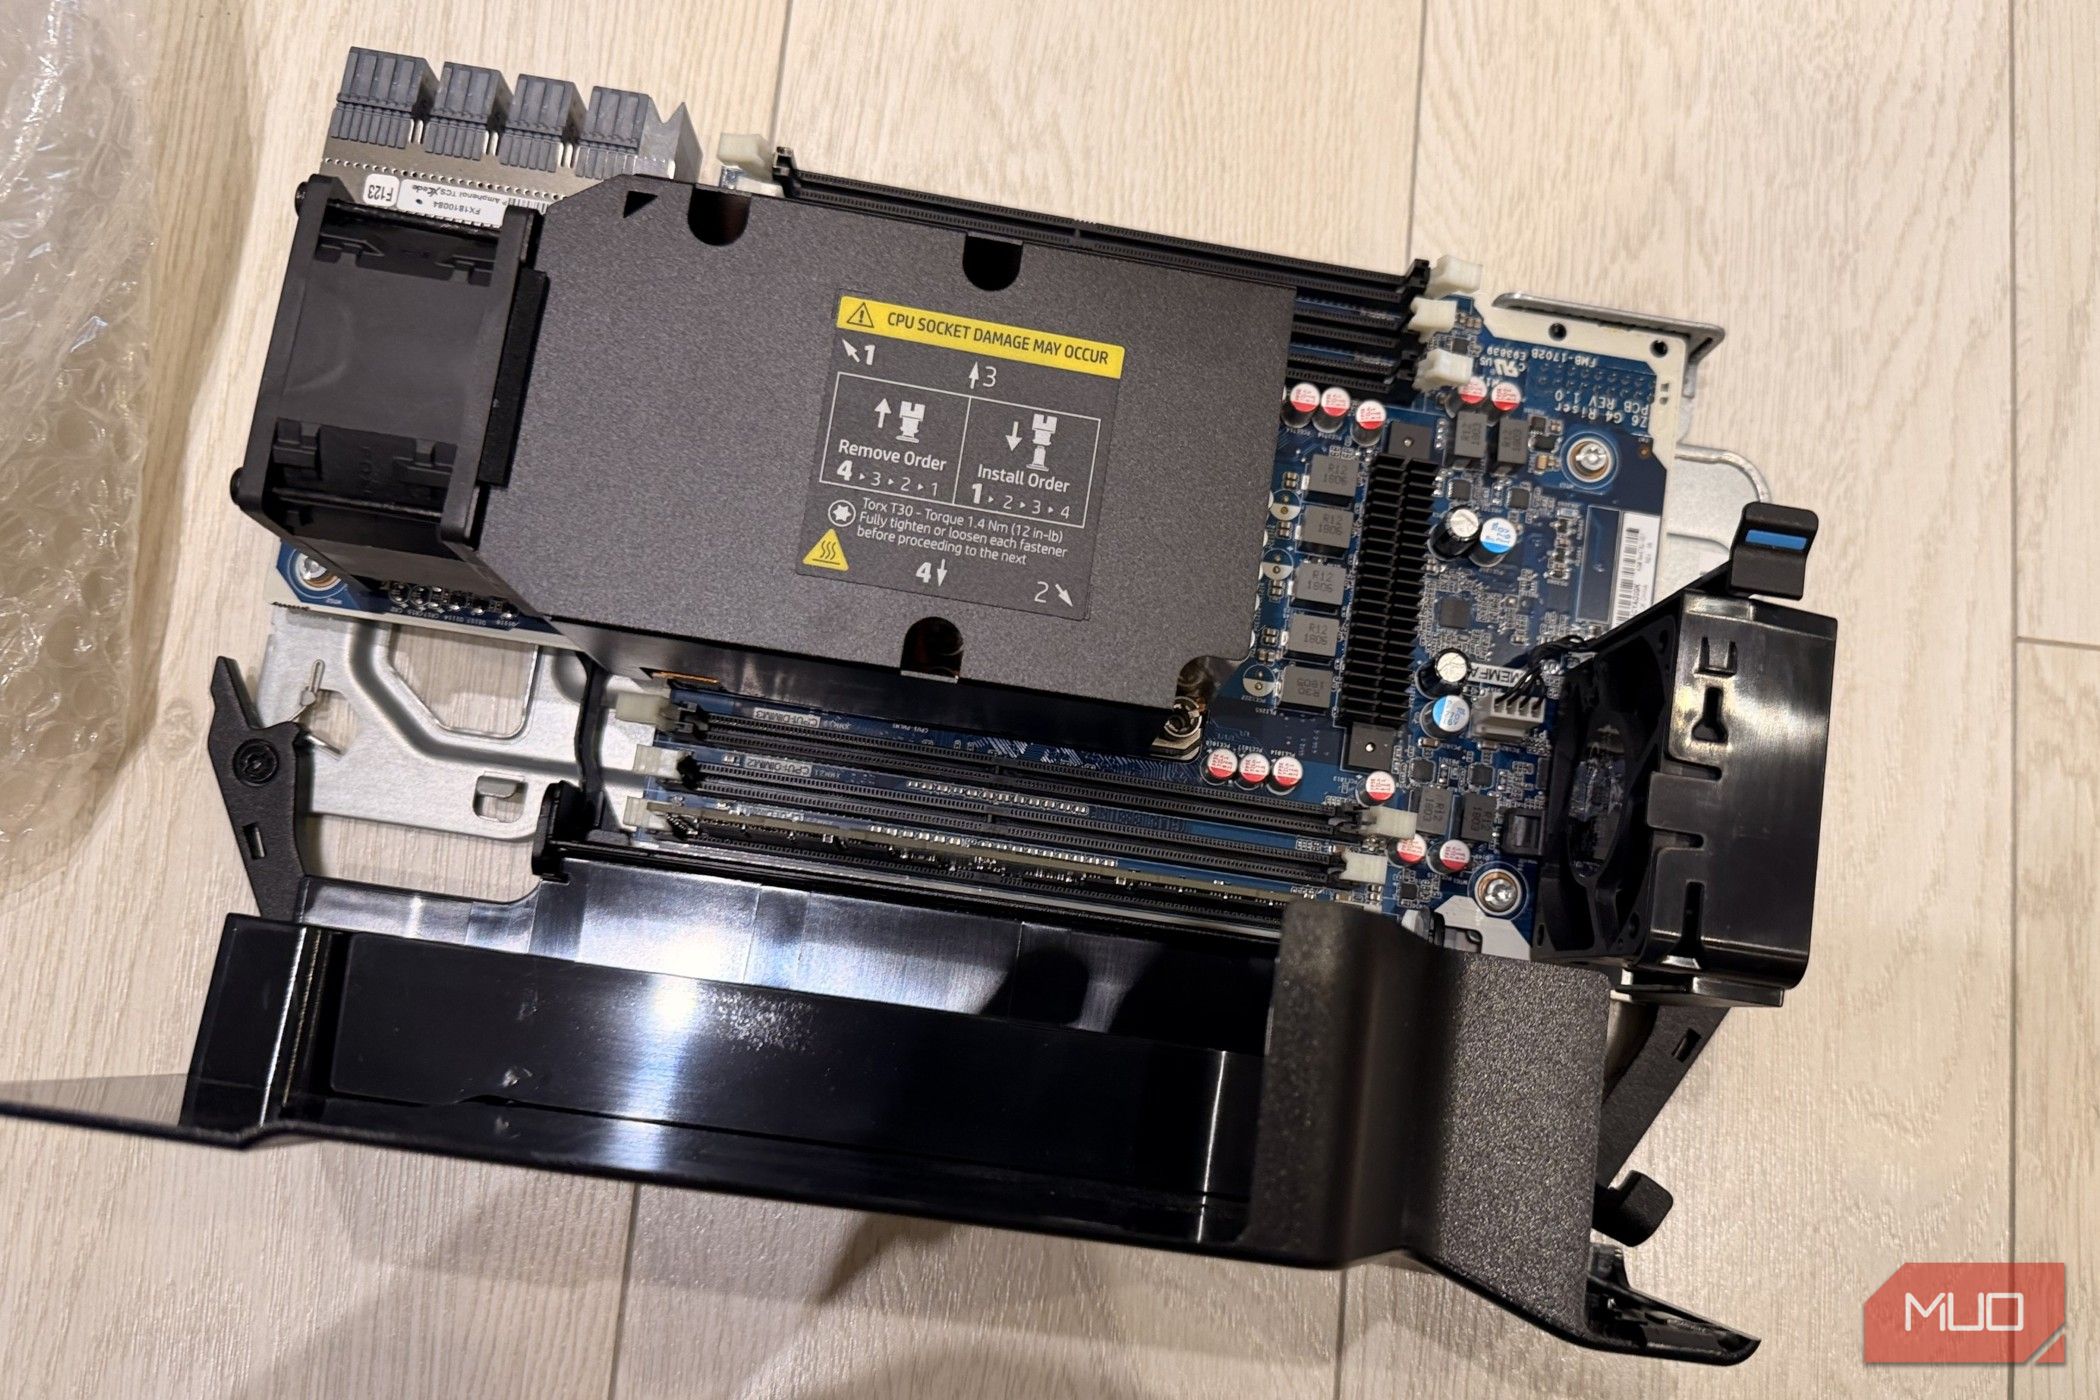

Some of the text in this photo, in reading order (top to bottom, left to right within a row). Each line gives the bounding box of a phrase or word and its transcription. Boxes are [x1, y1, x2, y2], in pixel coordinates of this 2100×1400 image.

[367, 184, 394, 202] F123
[440, 187, 457, 197] TCS
[459, 191, 501, 205] Amphenol
[433, 200, 481, 215] FX1810084
[887, 312, 1109, 364] CPU SOCKET DAMAGE MAY OCCUR
[864, 344, 876, 365] 1
[982, 365, 997, 387] 3
[1588, 395, 1616, 411] REV
[1624, 400, 1649, 416] PCB
[1555, 401, 1648, 428] Z6 G4 Riser
[838, 439, 947, 471] Remove Order
[836, 460, 938, 497] 4 3 2 1
[977, 463, 1070, 493] Install Order
[972, 483, 1070, 519] 1 2 3 4
[863, 497, 887, 512] Torx
[891, 502, 913, 517] T30
[924, 508, 964, 526] Torque
[968, 516, 985, 529] 1.4
[987, 520, 1008, 533] Nm
[1011, 523, 1031, 538] (12
[1032, 527, 1063, 543] in-lb)
[857, 524, 1027, 565] before proceeding to the next
[859, 511, 1068, 558] Fully tighten or loosen each fastener
[915, 562, 932, 583] 4
[1312, 570, 1334, 581] R12
[1034, 581, 1049, 603] 2
[1308, 622, 1328, 634] R12
